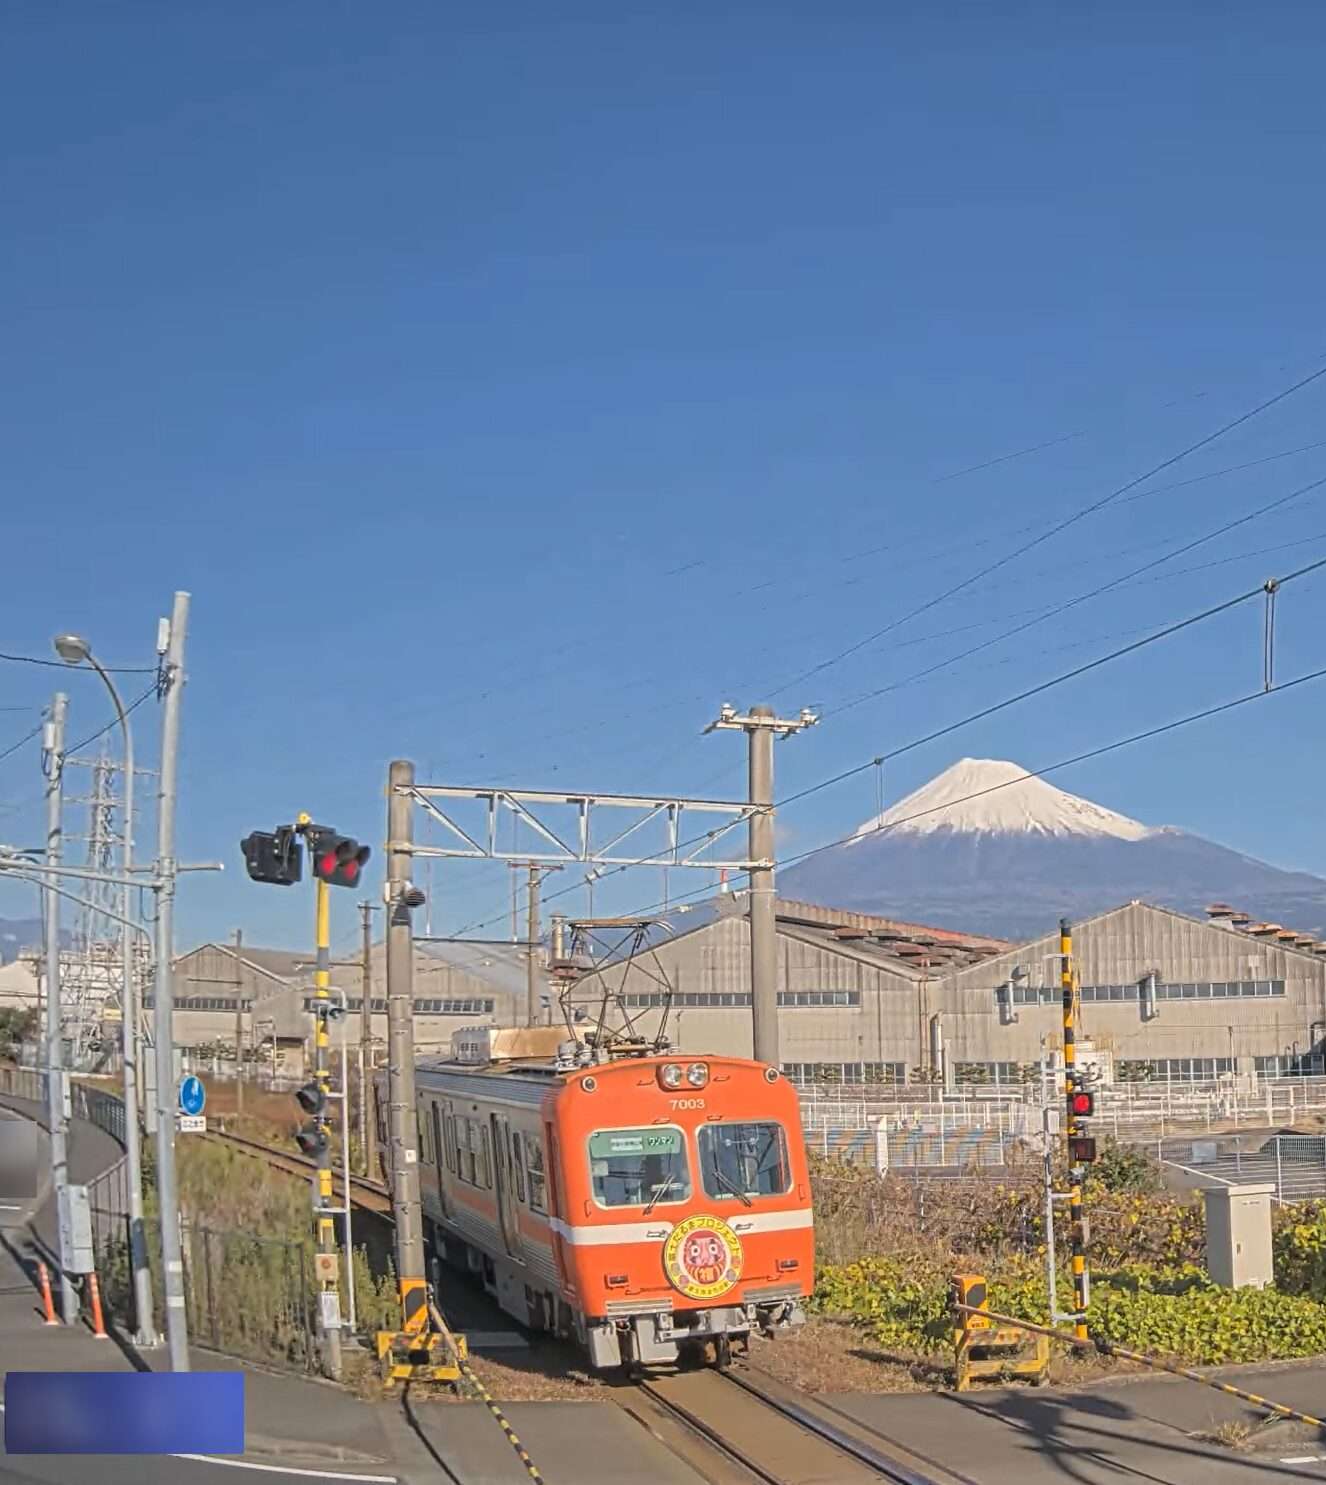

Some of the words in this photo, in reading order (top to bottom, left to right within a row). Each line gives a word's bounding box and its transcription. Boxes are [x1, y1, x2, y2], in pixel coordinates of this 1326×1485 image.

[669, 1099, 705, 1110] 7003
[648, 1136, 674, 1146] ワンマン
